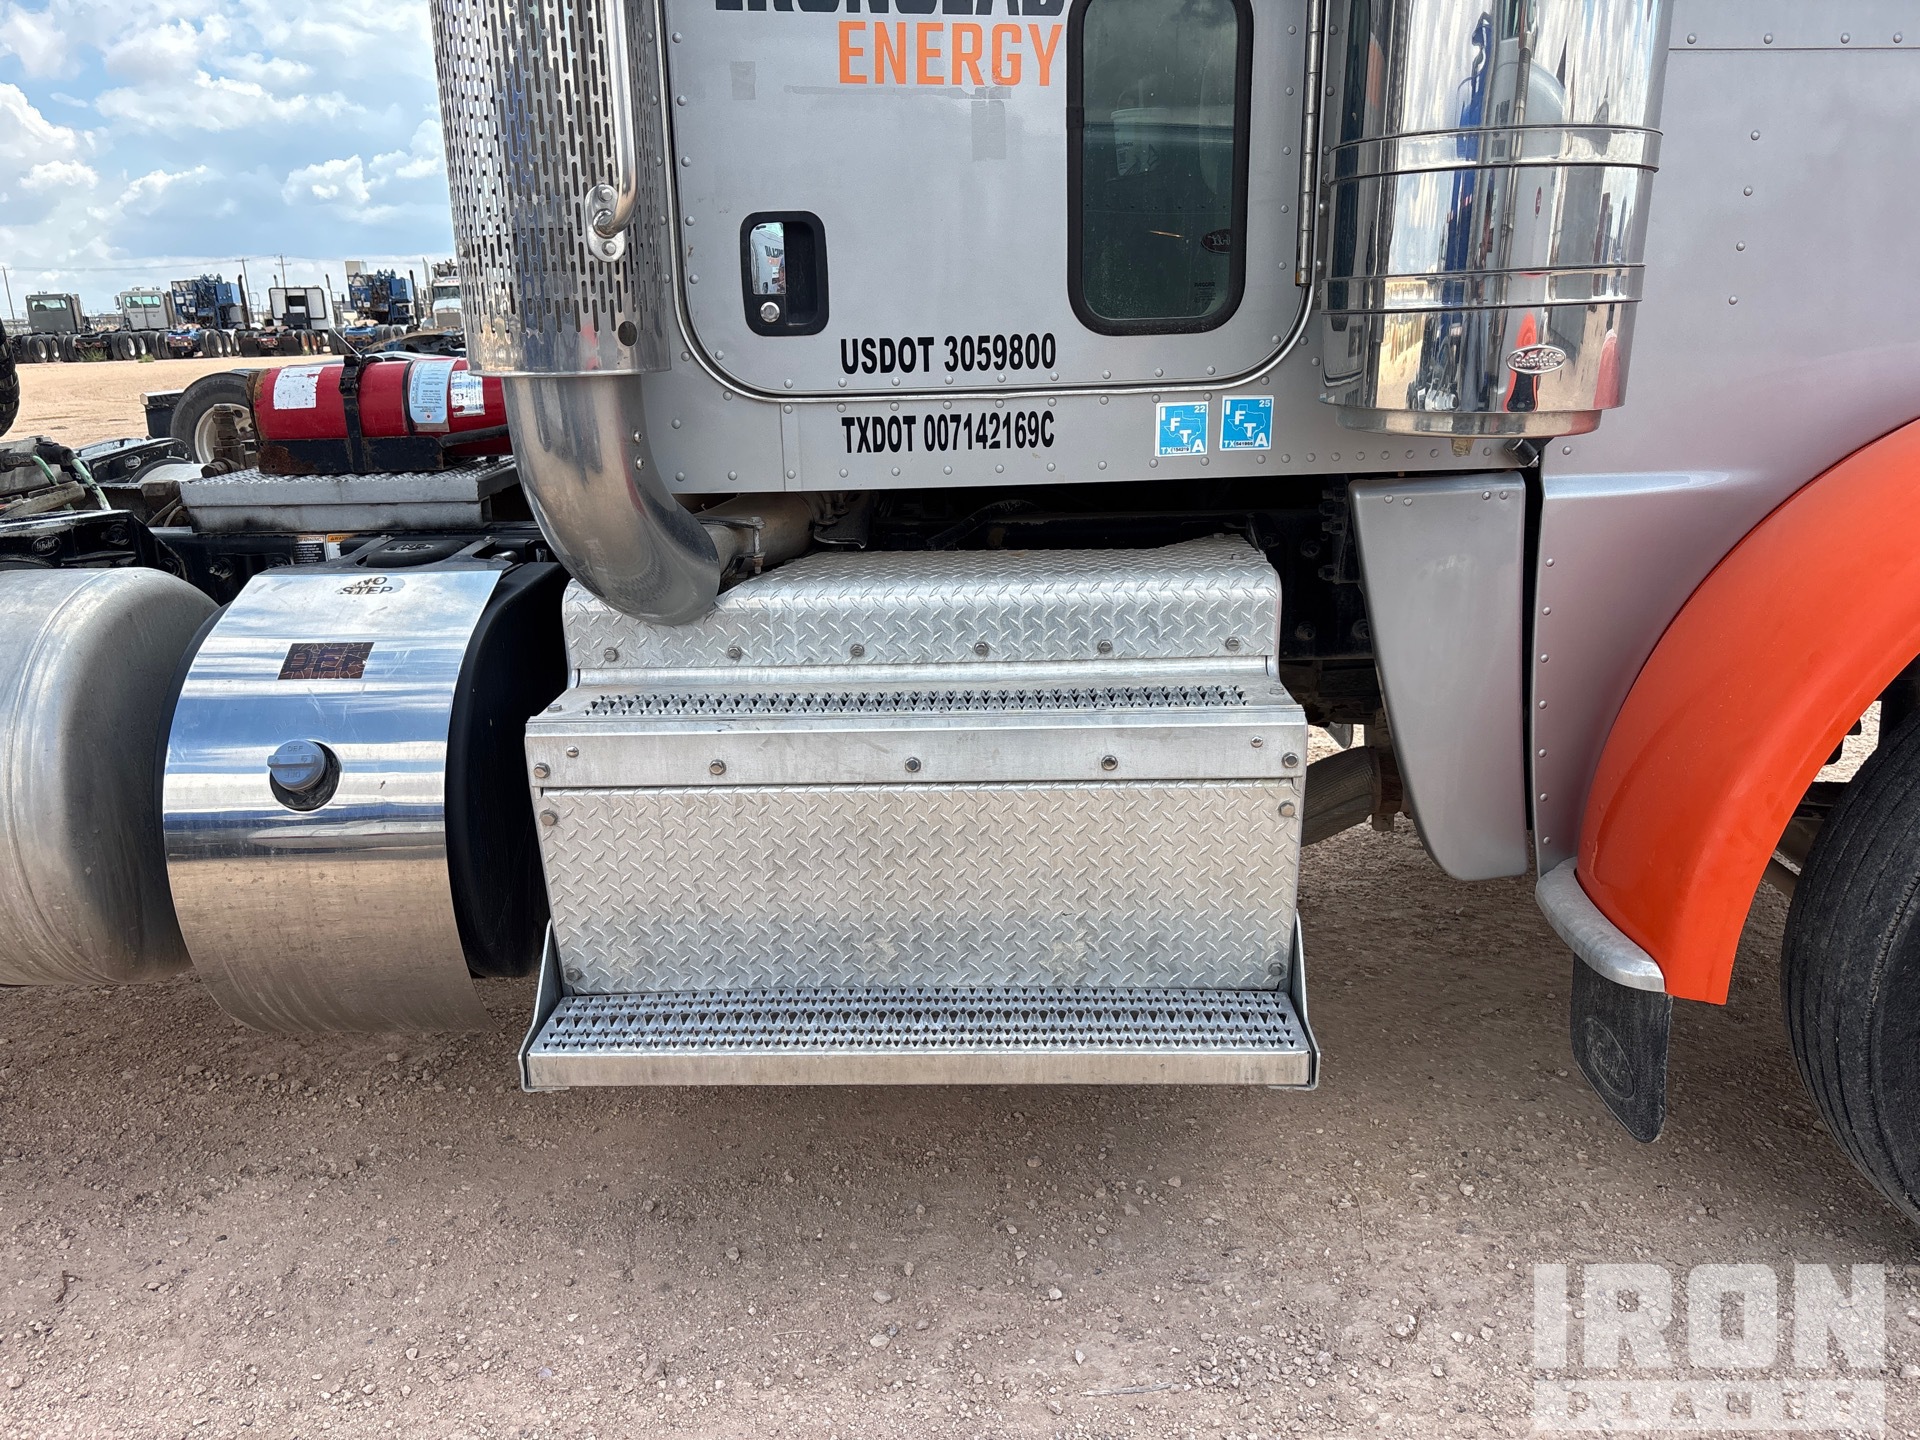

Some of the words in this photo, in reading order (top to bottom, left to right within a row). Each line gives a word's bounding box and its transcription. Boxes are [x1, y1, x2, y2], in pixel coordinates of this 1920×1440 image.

[838, 21, 1063, 86] ENERGY
[840, 337, 934, 374] USDOT
[944, 332, 1056, 372] 3059800
[1259, 400, 1271, 408] 25
[1194, 405, 1206, 413] 22
[841, 415, 916, 453] TXDOT
[923, 410, 1055, 452] 007142169C
[1223, 440, 1235, 448] TX
[357, 577, 388, 585] NO
[337, 586, 393, 595] STEP
